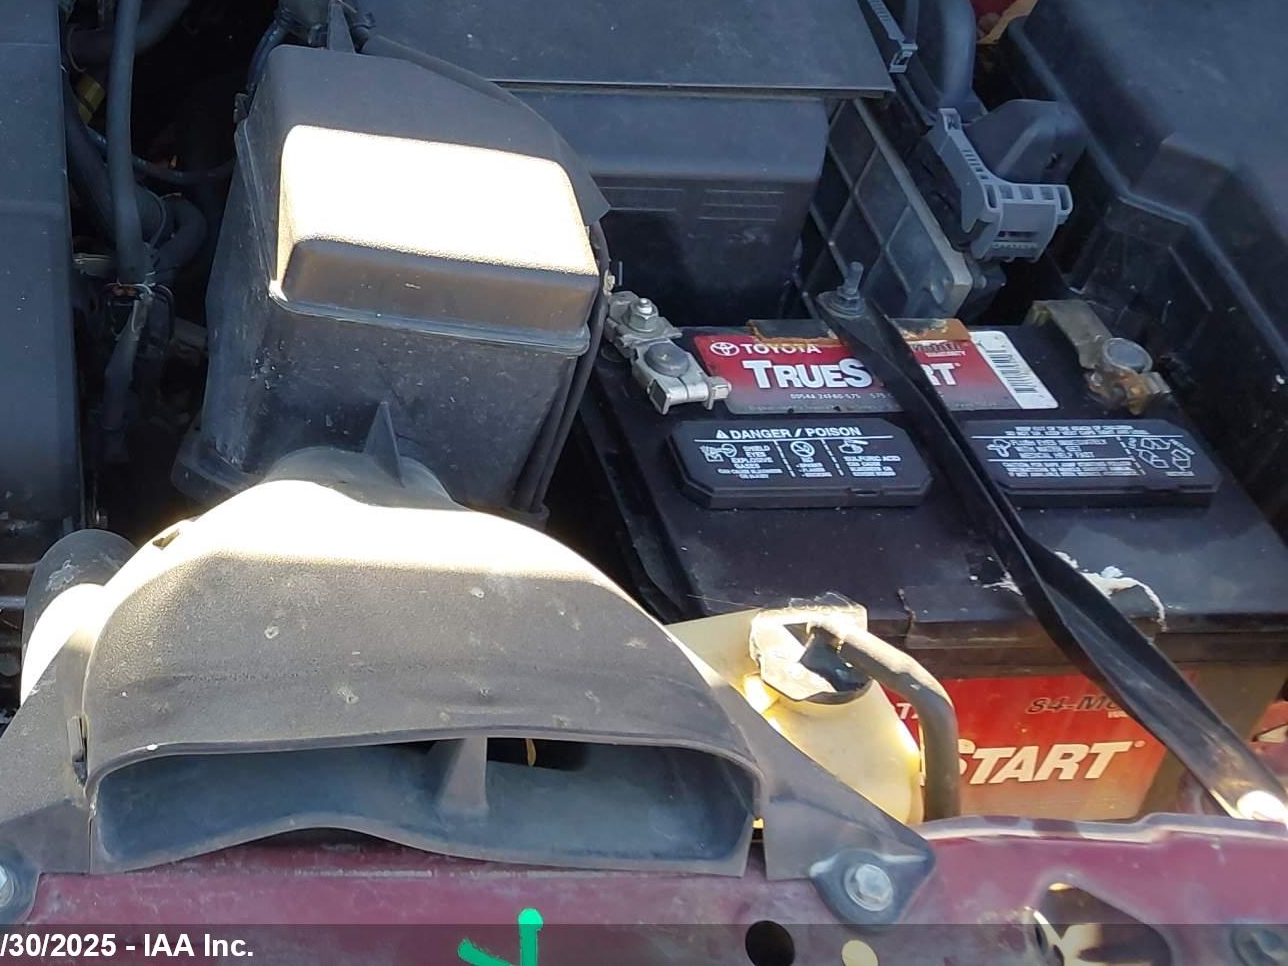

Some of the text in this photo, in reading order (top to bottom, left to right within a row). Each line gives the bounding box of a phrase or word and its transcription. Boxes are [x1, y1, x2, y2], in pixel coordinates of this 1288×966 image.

[741, 343, 823, 355] TOYOTA
[729, 429, 790, 440] DANGER
[806, 426, 862, 437] POISON
